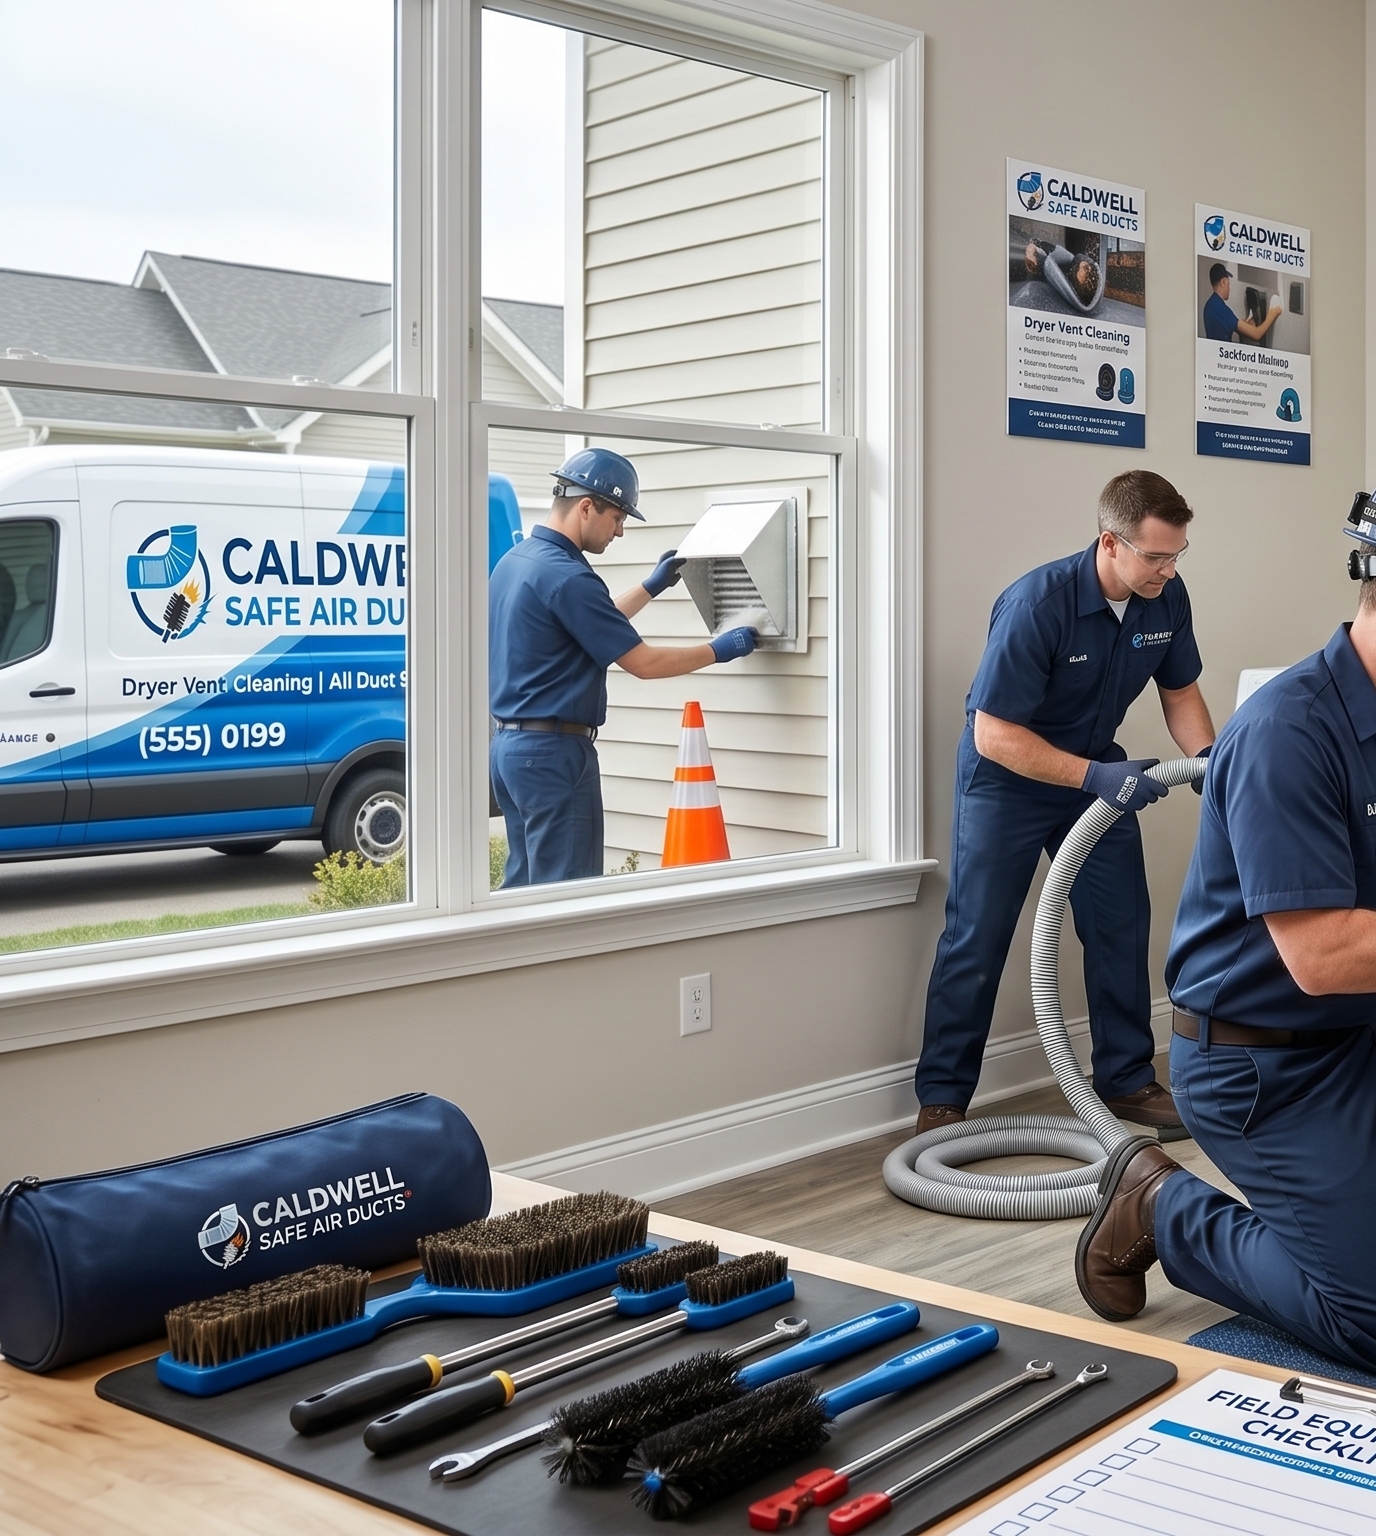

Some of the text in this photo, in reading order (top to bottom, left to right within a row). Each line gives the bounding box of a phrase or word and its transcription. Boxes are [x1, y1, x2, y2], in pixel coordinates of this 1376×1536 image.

[1047, 178, 1139, 215] CALDWELL
[1047, 200, 1138, 232] SAFE AIR DUCTS
[1229, 221, 1306, 253] CALDWELL
[1274, 251, 1304, 268] DUCTS
[1024, 316, 1056, 333] Dryer
[1058, 320, 1083, 336] Vent
[1085, 326, 1130, 346] Cleaning
[225, 596, 301, 626] SAFE
[309, 597, 358, 626] AIR
[122, 677, 178, 699] Dryer
[183, 676, 227, 694] Vent
[233, 674, 313, 695] Cleaning
[329, 671, 352, 690] All
[357, 671, 396, 689] Duct
[139, 722, 286, 759] (555) 0199
[252, 1167, 405, 1227] CALDWELL
[259, 1194, 406, 1250] SAFE AIR DUCTS
[1207, 1389, 1299, 1420] FIELD
